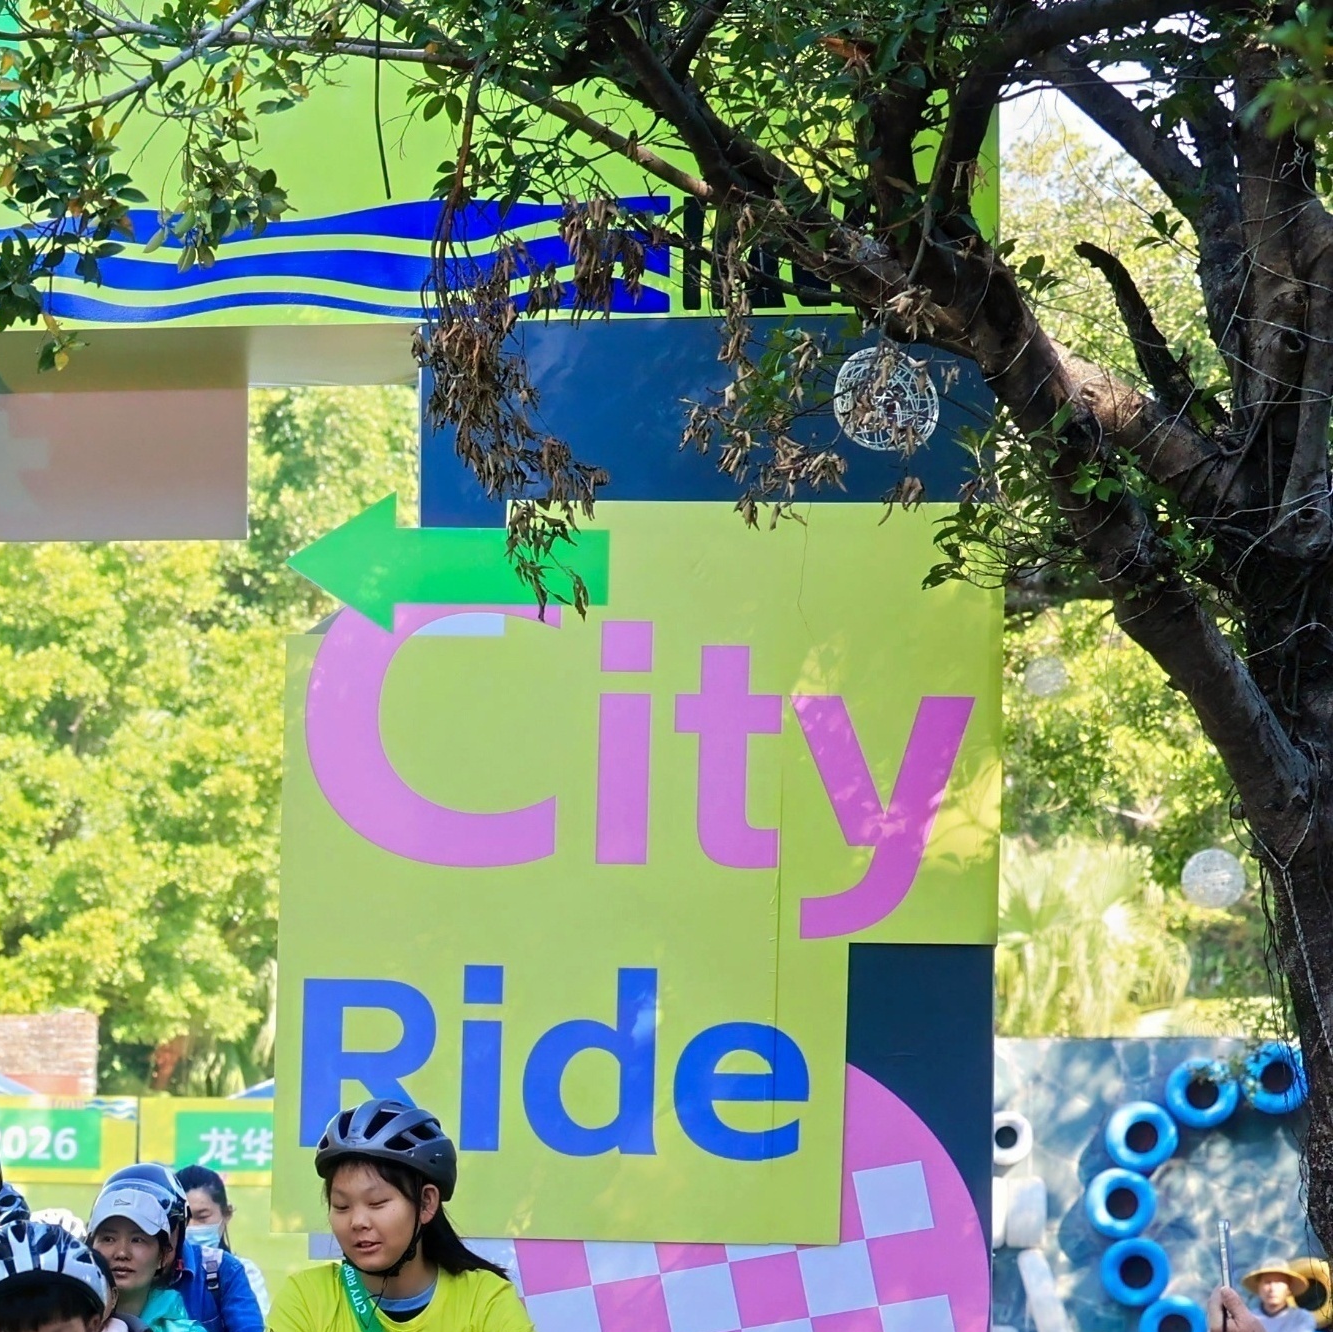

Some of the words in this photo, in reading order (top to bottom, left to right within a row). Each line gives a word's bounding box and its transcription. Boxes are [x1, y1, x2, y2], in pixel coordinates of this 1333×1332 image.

[304, 604, 976, 939] City
[298, 965, 810, 1162] Ride
[349, 1286, 368, 1315] CITY
